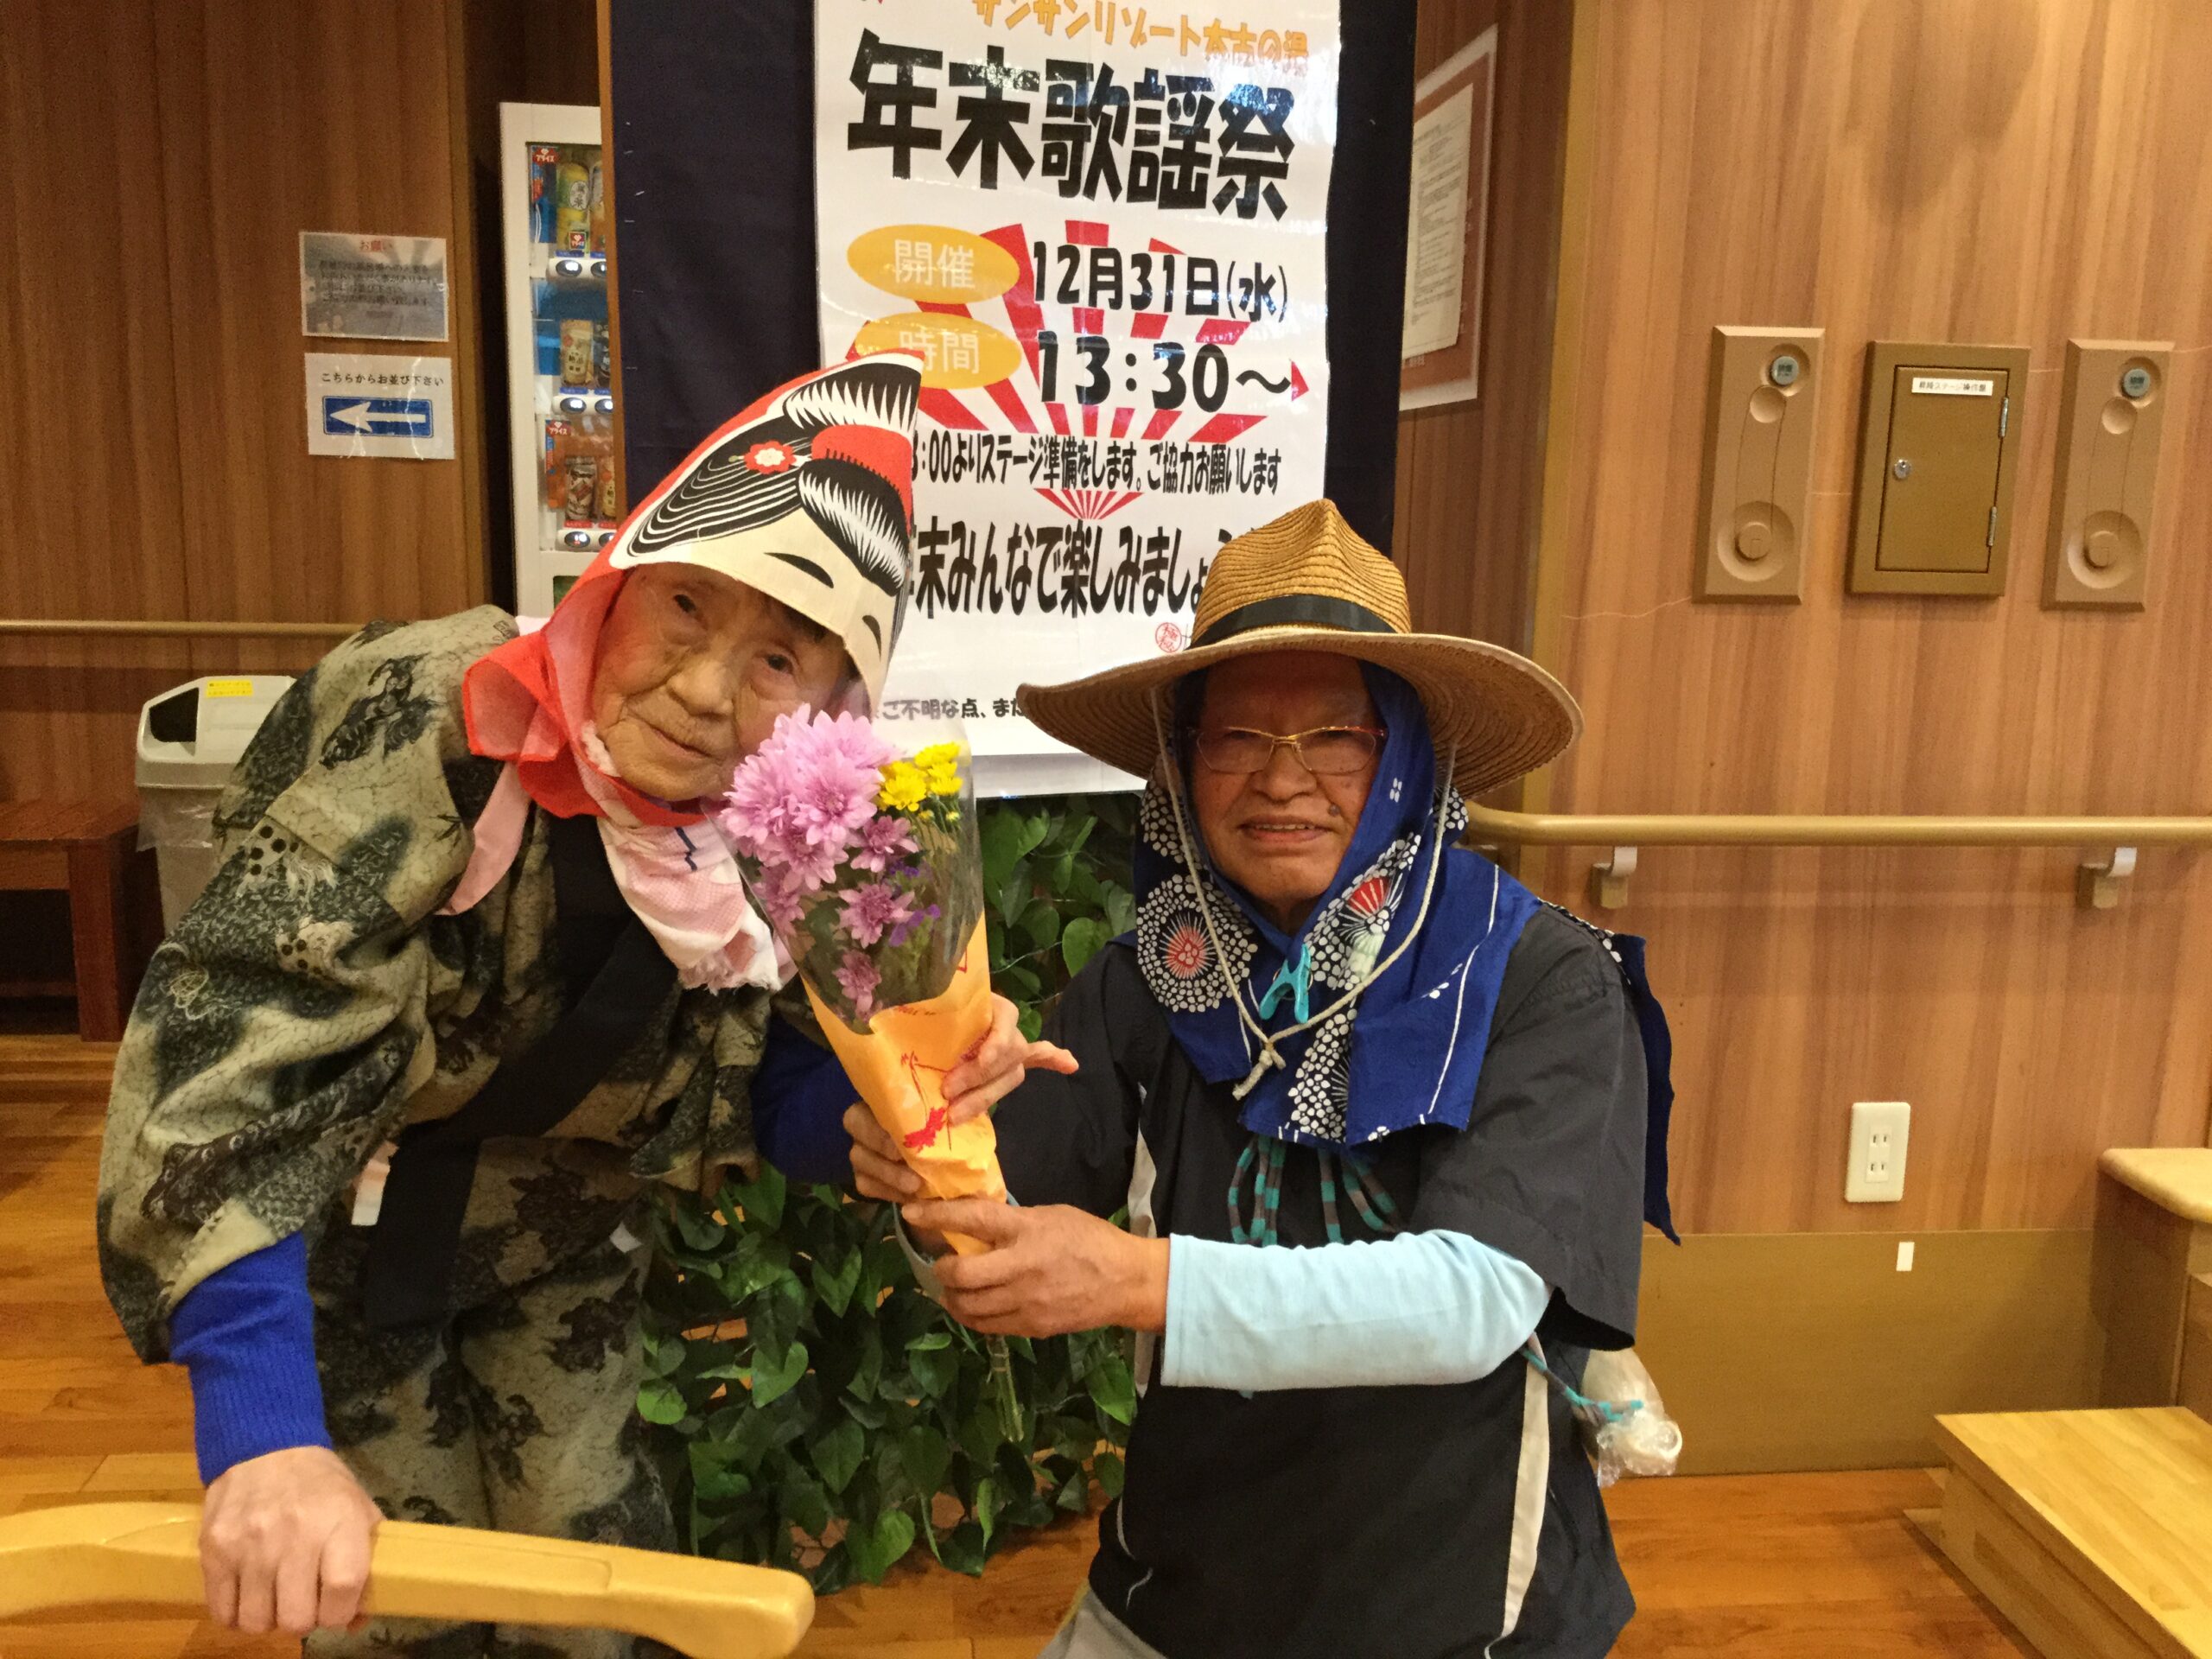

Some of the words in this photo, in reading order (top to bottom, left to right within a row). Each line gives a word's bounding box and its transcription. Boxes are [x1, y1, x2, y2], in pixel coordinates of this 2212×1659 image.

[848, 28, 1295, 221] 年末歌謡祭
[895, 239, 976, 289] 開催
[1033, 241, 1288, 323] 12月31日(水)
[321, 372, 444, 386] こちらからお並び下さい
[899, 328, 979, 374] 時間
[910, 515, 1233, 619] 末みんなで楽しみましょ
